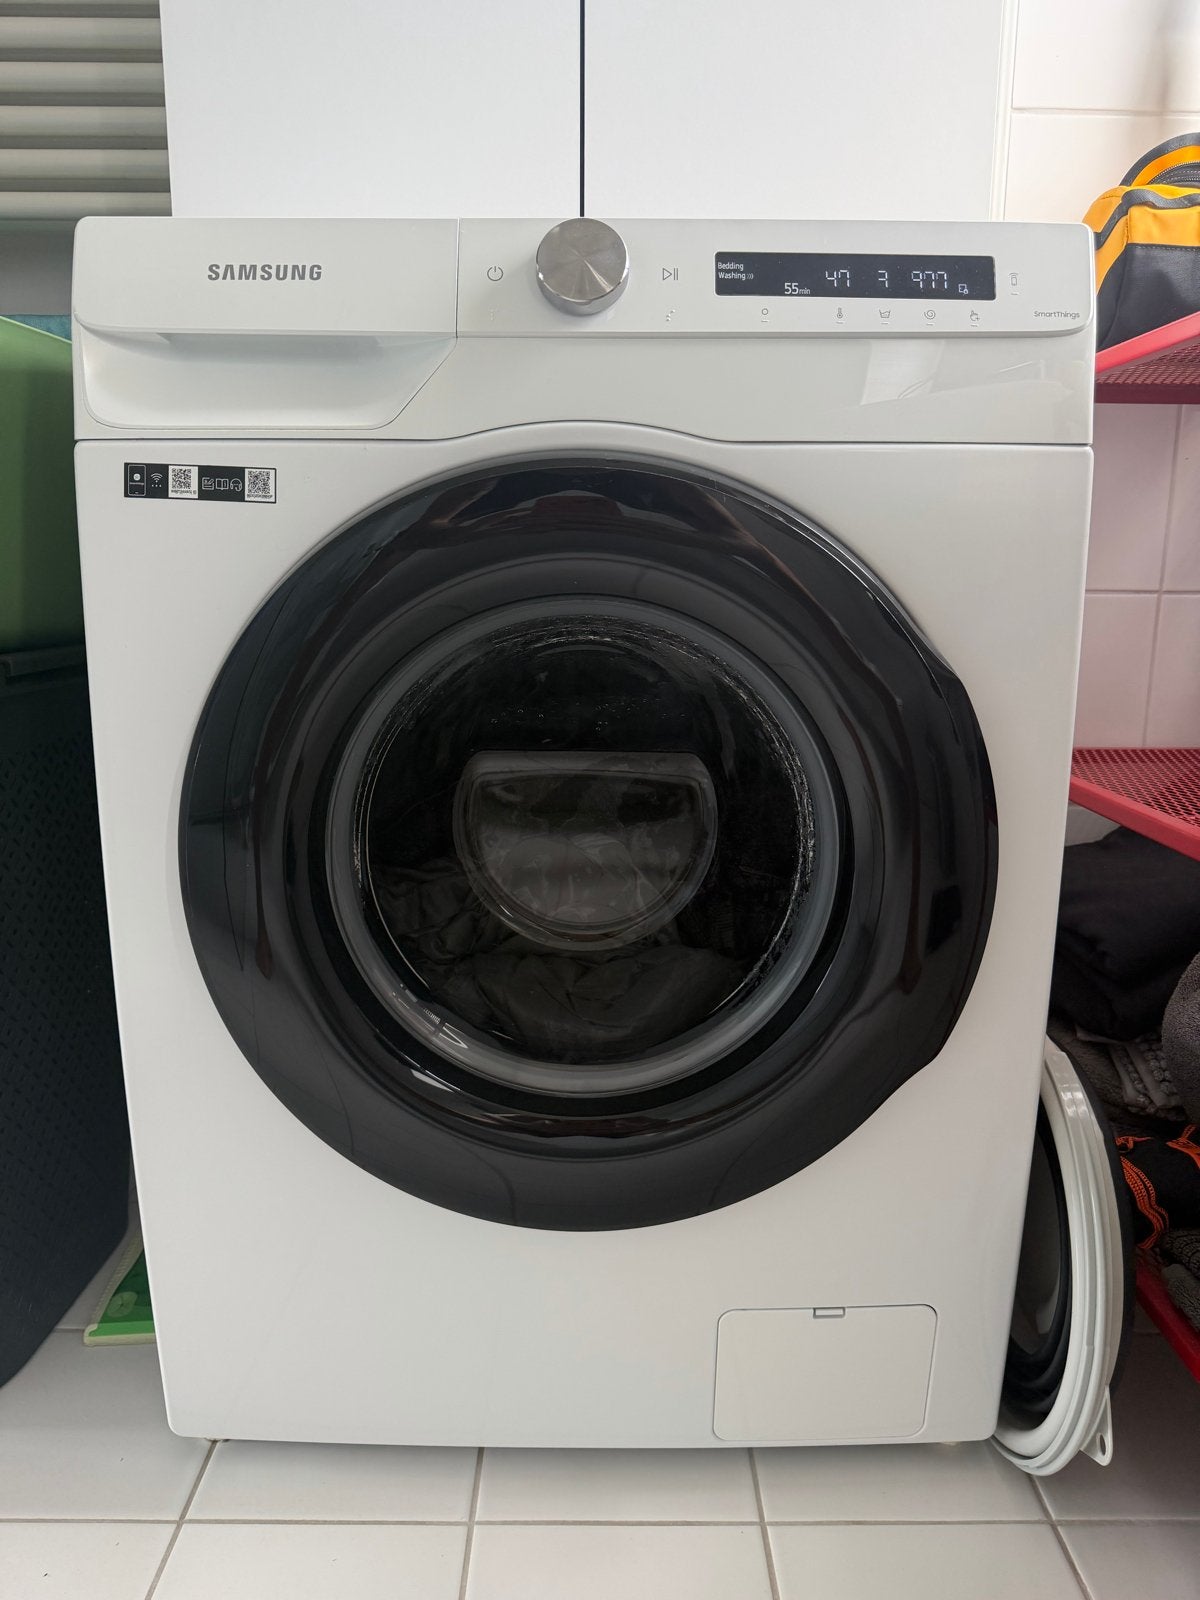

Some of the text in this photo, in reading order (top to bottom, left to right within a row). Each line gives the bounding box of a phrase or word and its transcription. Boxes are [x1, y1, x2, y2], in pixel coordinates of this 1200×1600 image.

[717, 261, 744, 271] Bedding
[207, 263, 322, 281] SAMSUNG
[718, 271, 746, 281] Washing
[1033, 310, 1081, 320] SmartThings
